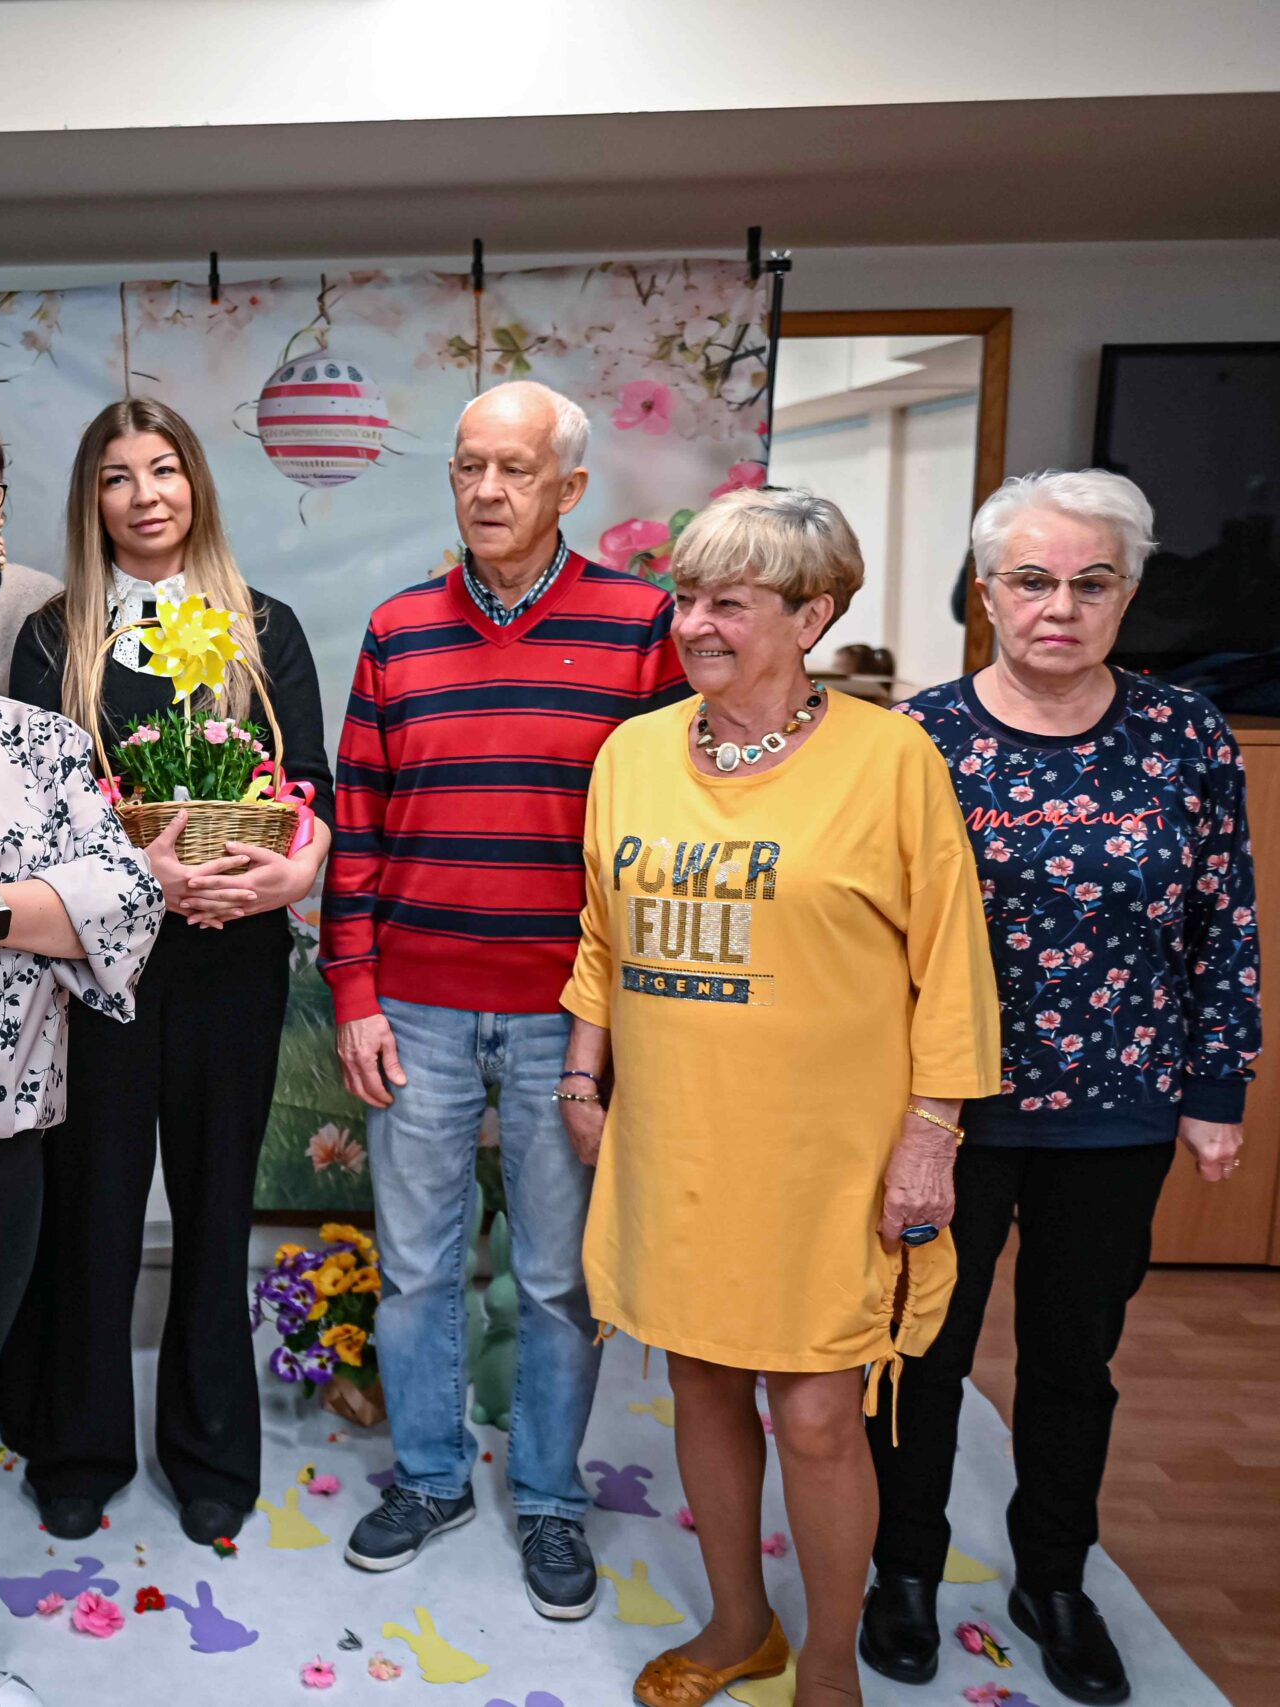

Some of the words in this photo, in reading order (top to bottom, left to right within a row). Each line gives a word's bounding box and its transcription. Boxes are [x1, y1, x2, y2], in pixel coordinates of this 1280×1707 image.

[613, 835, 781, 900] POWER
[634, 897, 744, 964] FULL
[627, 973, 736, 996] EGEND
